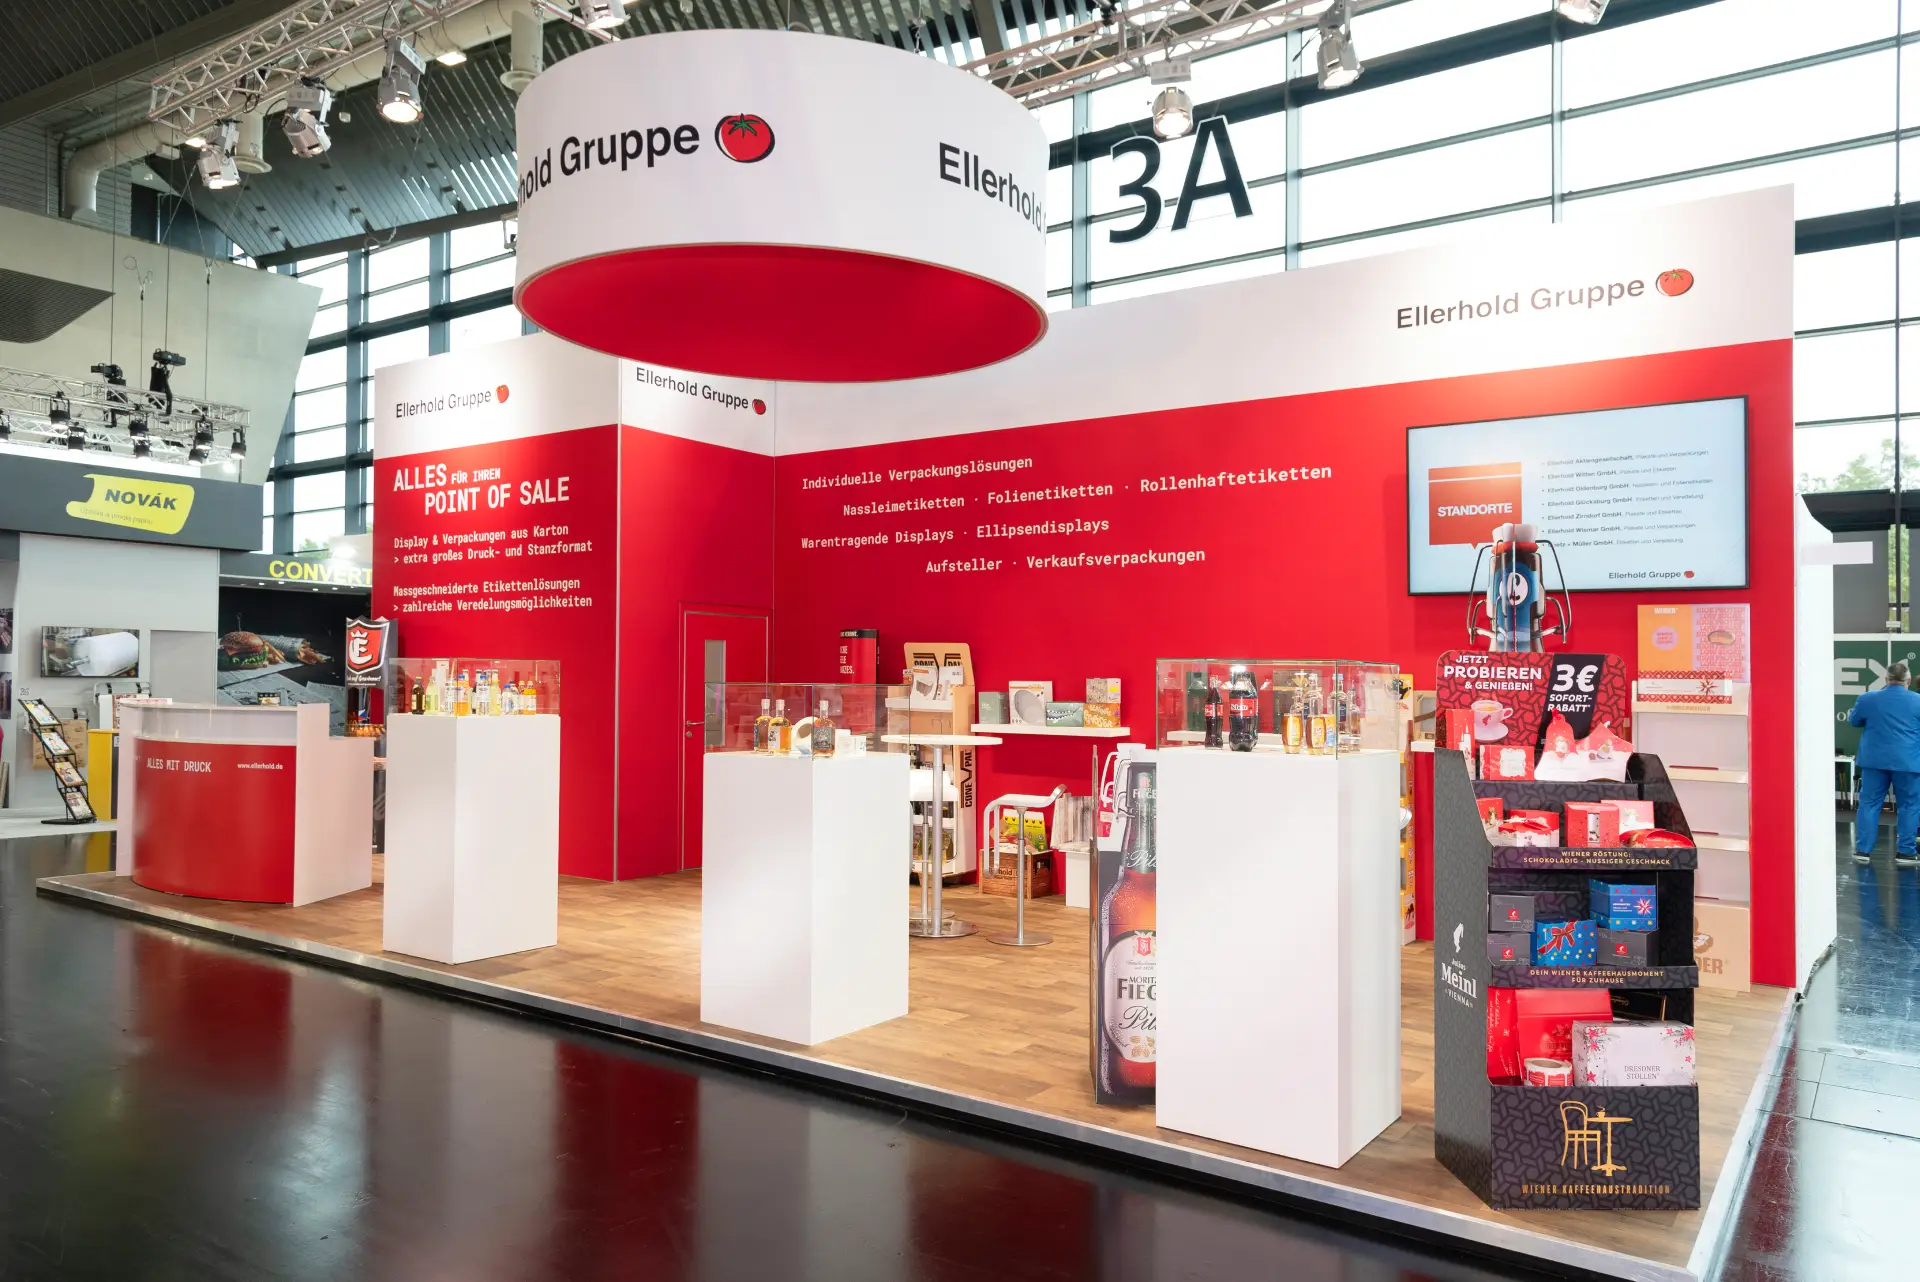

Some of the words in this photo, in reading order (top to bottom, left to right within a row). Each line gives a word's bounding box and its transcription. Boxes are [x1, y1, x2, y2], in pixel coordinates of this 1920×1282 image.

[560, 124, 700, 176] Gruppe
[940, 142, 1042, 233] Ellerhold
[1110, 115, 1253, 243] 3A
[1397, 292, 1519, 329] Ellerhold
[1530, 279, 1645, 309] Gruppe
[636, 367, 698, 396] Ellerhold
[701, 385, 749, 410] Gruppe
[396, 395, 444, 418] Ellerhold
[448, 390, 492, 410] Gruppe
[393, 463, 447, 491] ALLES
[451, 470, 468, 484] FÜR
[473, 468, 501, 482] IHREN
[802, 471, 882, 489] Individuelle
[888, 458, 1033, 481] Verpackungslösungen
[105, 488, 178, 510] NOVÁK
[425, 487, 480, 515] POINT
[487, 484, 512, 508] OF
[519, 476, 570, 505] SALE
[843, 497, 965, 516] Nassleimetiketten
[987, 483, 1113, 504] Folienetiketten
[1140, 465, 1332, 492] Rollenhaftetiketten
[1437, 502, 1513, 517] STANDORTE
[394, 535, 428, 550] Display
[432, 535, 439, 545] &
[442, 529, 506, 546] Verpackungen
[511, 529, 528, 540] aus
[533, 525, 569, 537] Karton
[801, 532, 889, 549] Warentragende
[895, 529, 954, 544] Displays
[976, 518, 1109, 539] Ellipsendisplays
[403, 552, 428, 564] extra
[432, 549, 463, 564] großes
[467, 546, 500, 560] Druck-
[505, 544, 522, 557] und
[527, 540, 592, 555] Stanzformat
[925, 559, 1002, 573] Aufsteller
[1027, 549, 1206, 569] Verkaufsverpackungen
[1608, 571, 1646, 579] Ellerhold
[1648, 571, 1681, 579] Gruppe
[393, 581, 478, 598] Massgeschneiderte
[483, 578, 581, 593] Etikettenlösungen
[403, 600, 453, 612] zahlreiche
[457, 595, 592, 612] Veredelungsmöglichkeiten
[1455, 655, 1489, 664] JETZT
[1444, 666, 1542, 680] PROBIEREN
[1464, 681, 1473, 689] &
[1551, 663, 1599, 692] 3€
[1549, 693, 1593, 703] SOFORT-
[146, 757, 164, 770] ALLES
[166, 760, 180, 771] MIT
[183, 761, 212, 773] DRUCK
[237, 762, 283, 770] www.ellerhold.de
[965, 782, 973, 808] CONE
[1592, 850, 1631, 858] RÖSTUNG:
[1128, 976, 1157, 984] MORIT
[1441, 962, 1477, 998] Meinl
[1118, 1005, 1157, 1031] Pil
[1624, 1065, 1661, 1073] DRESDNER
[1522, 1184, 1557, 1194] WIENER
[1562, 1184, 1670, 1195] KAFFEEHAUSTRADITION
